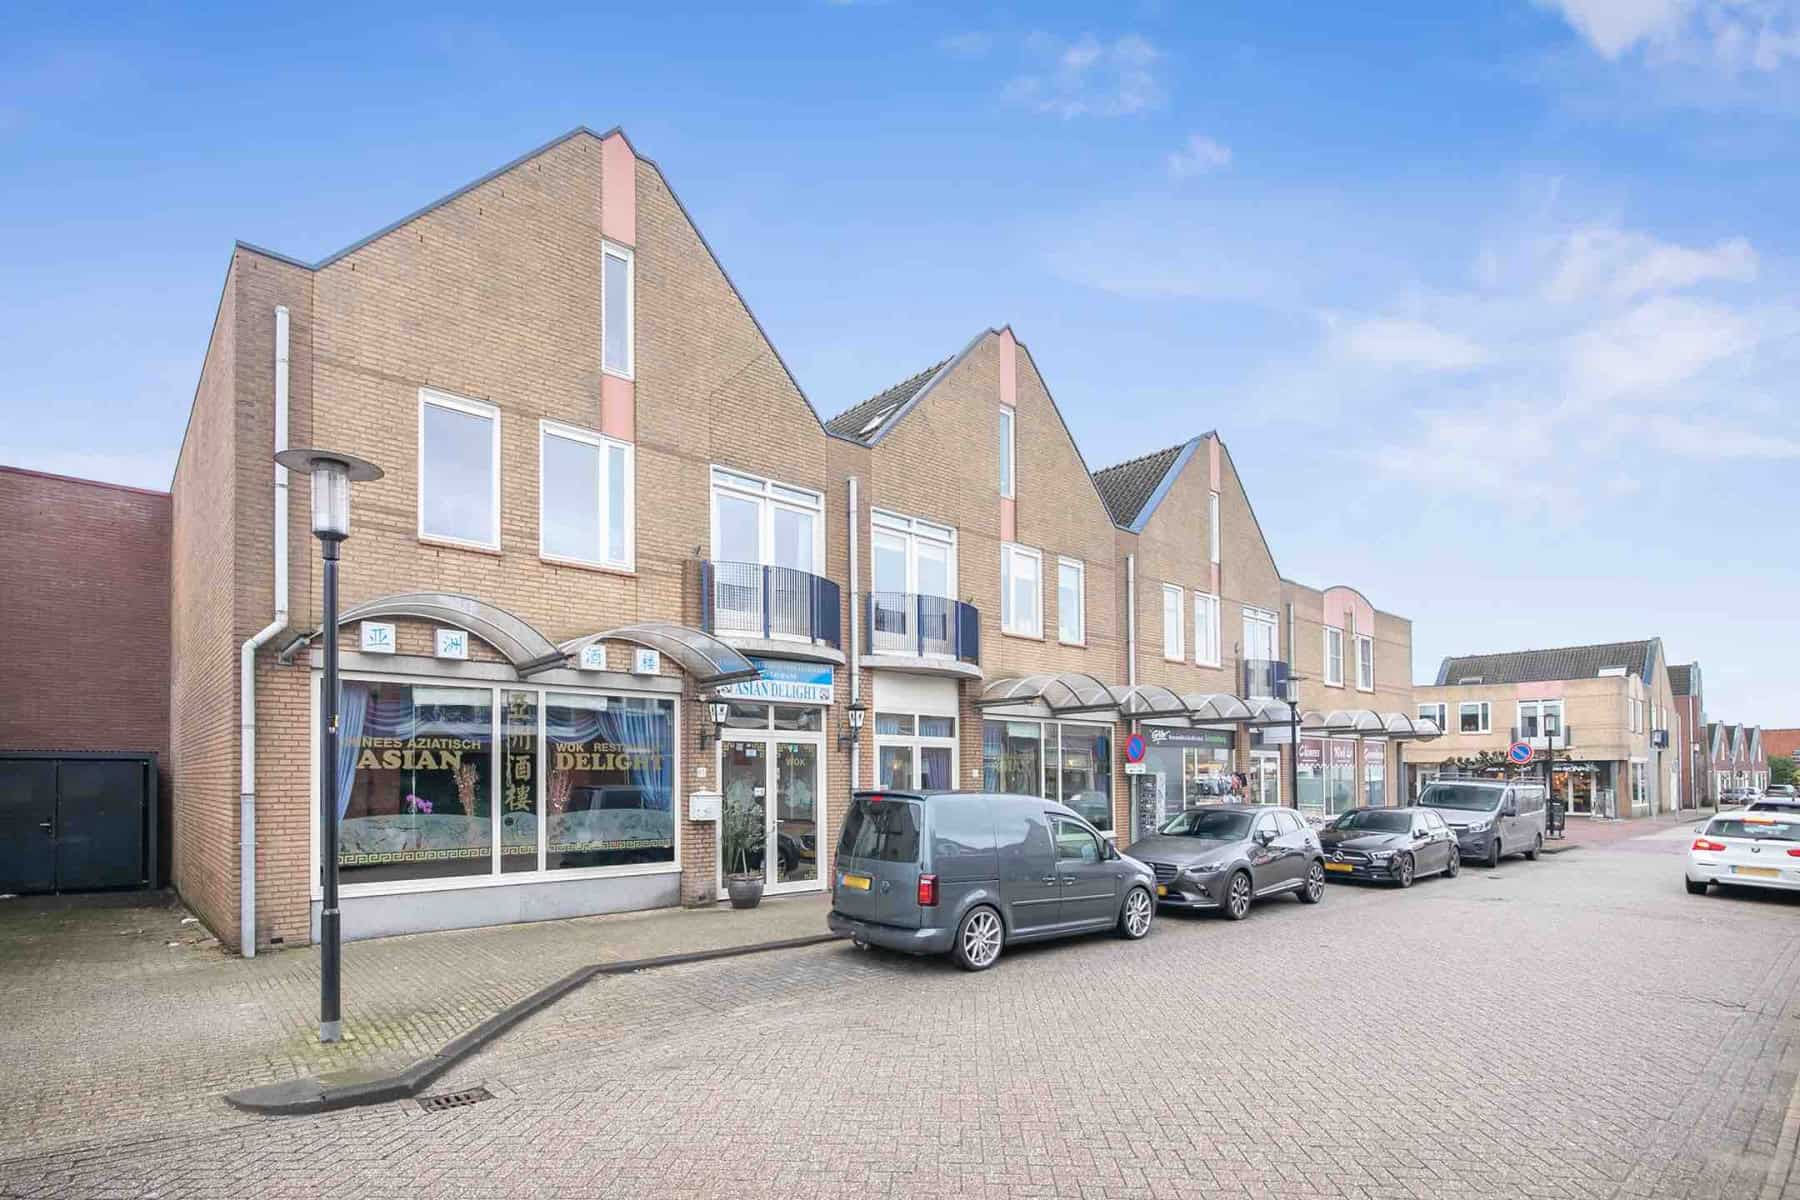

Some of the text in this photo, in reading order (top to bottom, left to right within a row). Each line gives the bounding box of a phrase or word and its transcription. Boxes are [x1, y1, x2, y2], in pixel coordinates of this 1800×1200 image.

[735, 680, 817, 700] ASIAN DELIGHT
[407, 737, 481, 750] AZIATISCH
[555, 743, 585, 753] WOK
[356, 749, 464, 770] ASIAN
[555, 752, 664, 771] DELIGHT
